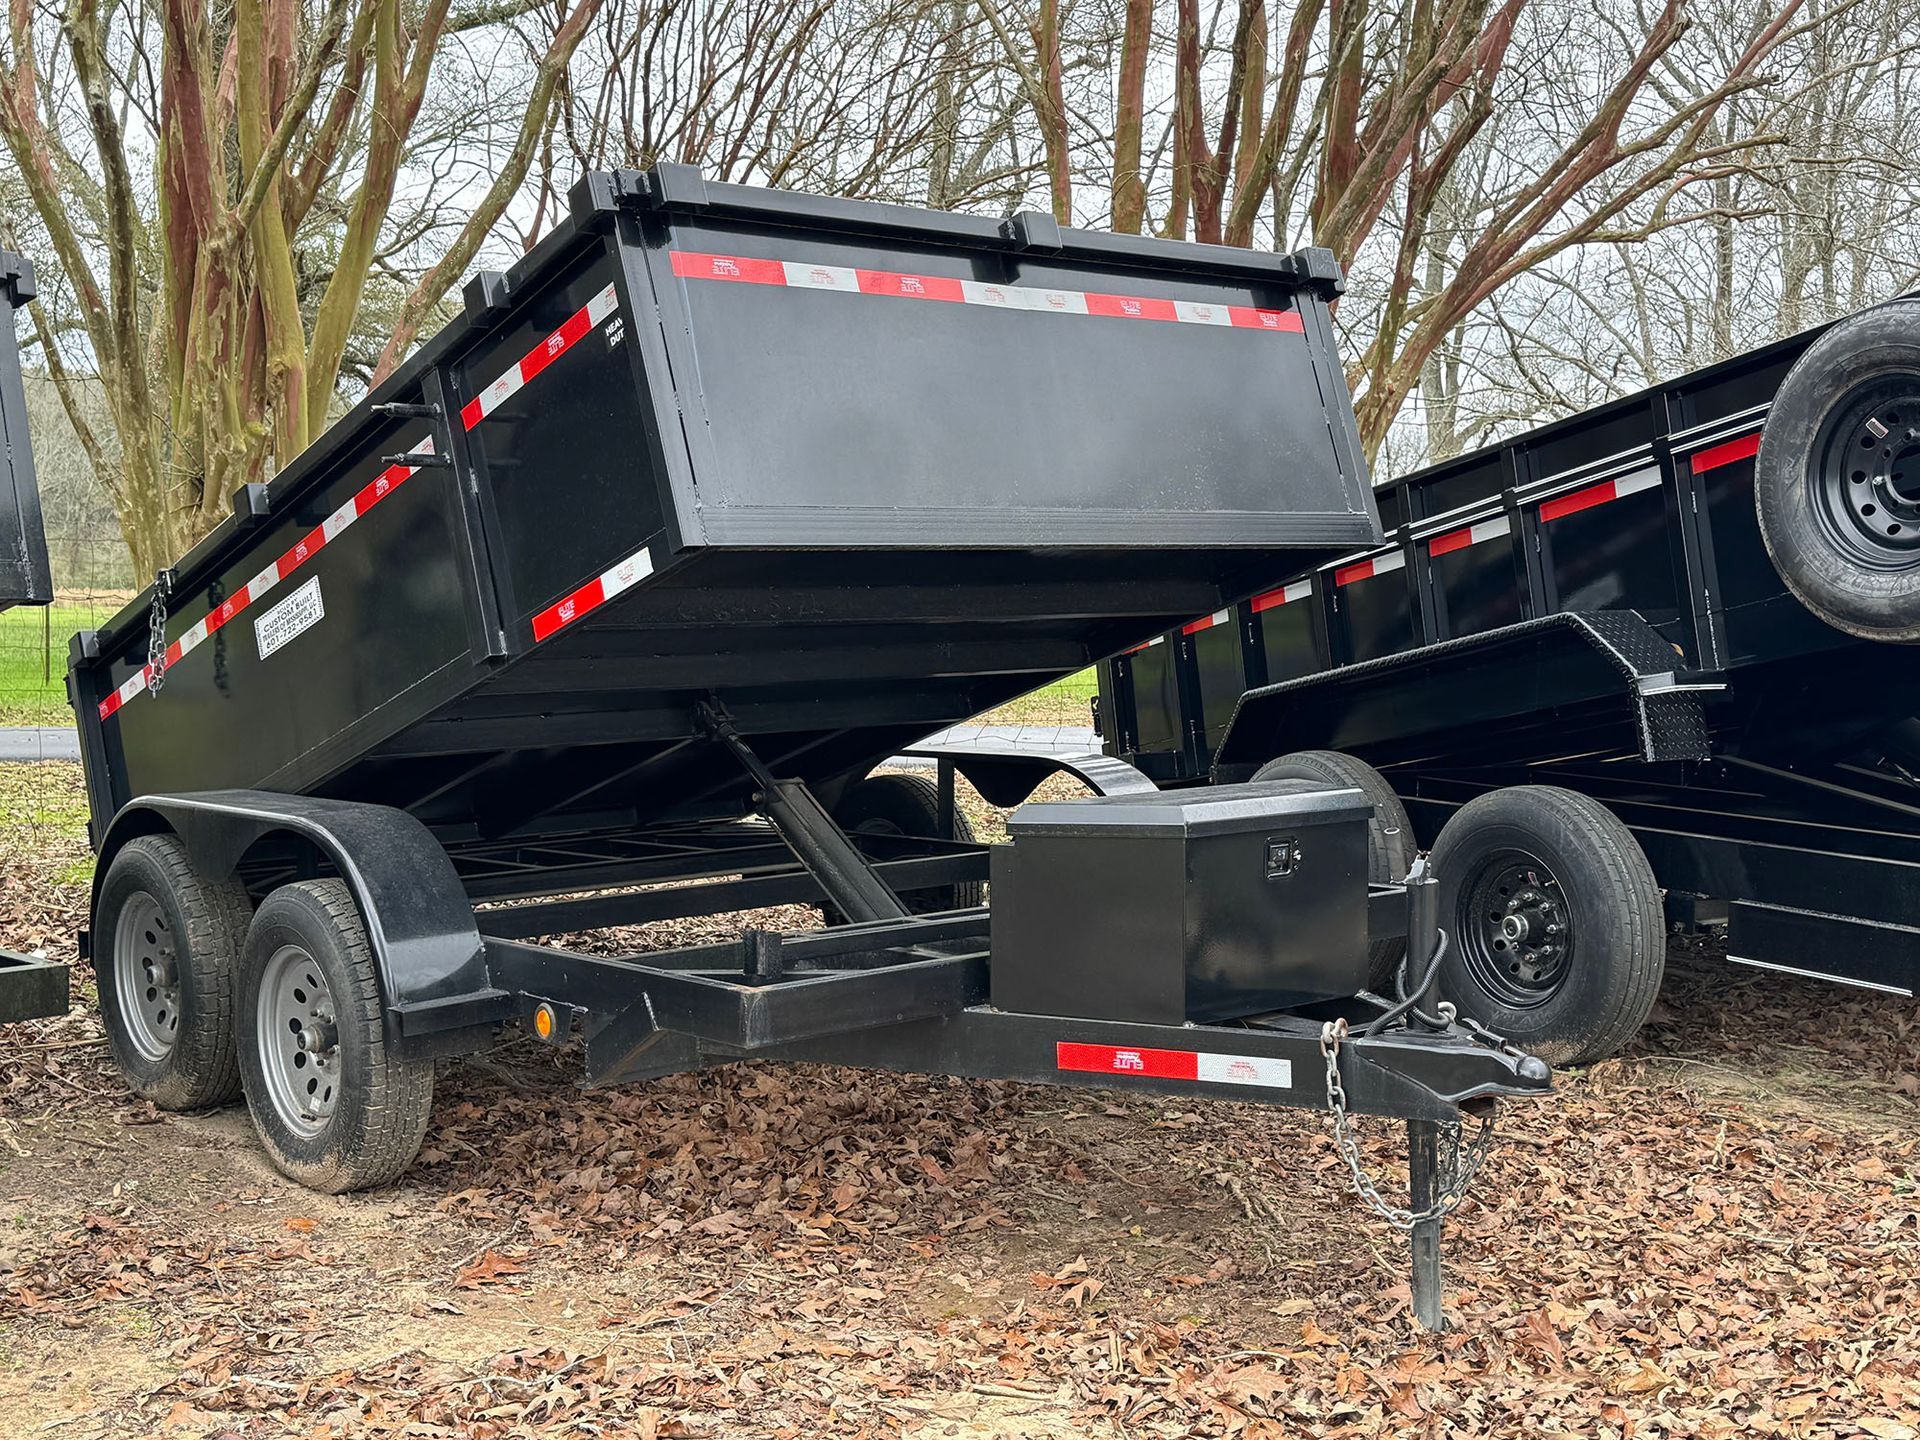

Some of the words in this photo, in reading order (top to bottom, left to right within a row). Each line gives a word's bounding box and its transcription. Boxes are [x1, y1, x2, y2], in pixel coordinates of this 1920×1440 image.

[263, 607, 294, 633] CUSTOM
[295, 591, 313, 610] BUILT
[266, 608, 317, 649] 601-722-9581
[1113, 1058, 1144, 1071] ELITE
